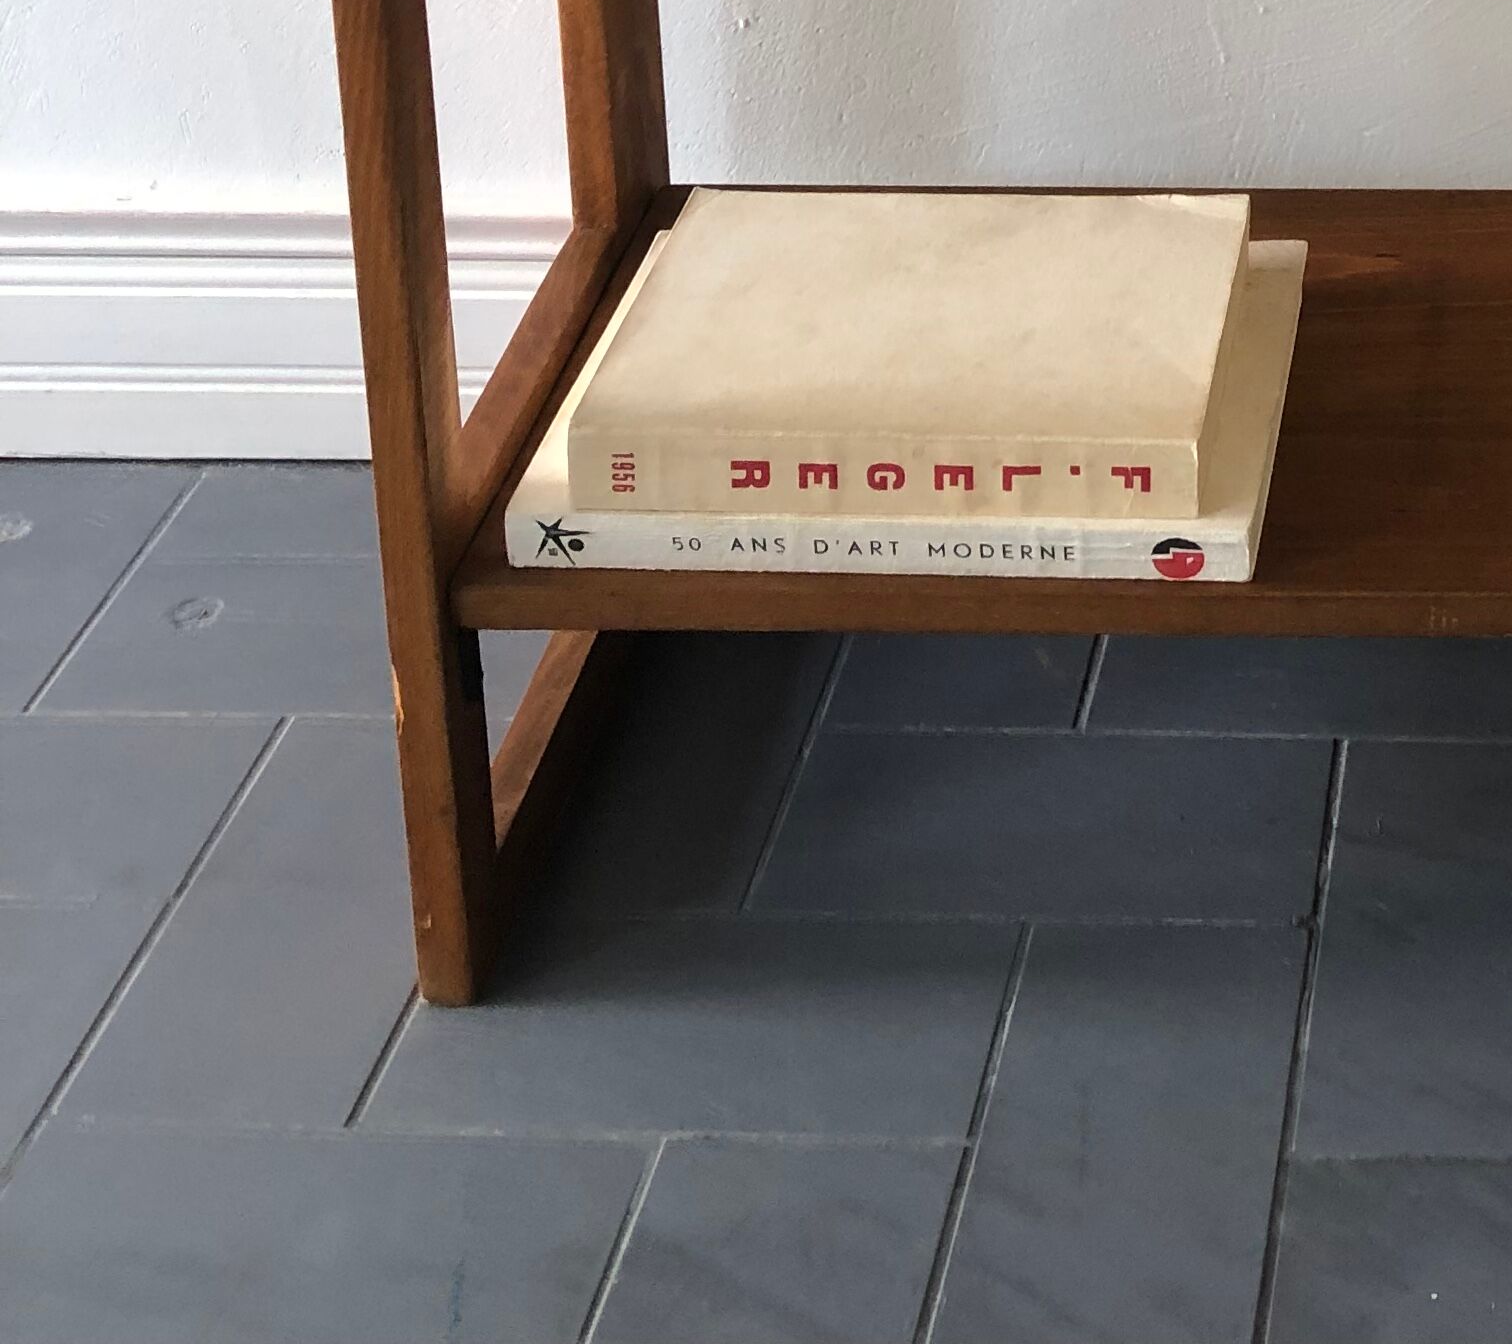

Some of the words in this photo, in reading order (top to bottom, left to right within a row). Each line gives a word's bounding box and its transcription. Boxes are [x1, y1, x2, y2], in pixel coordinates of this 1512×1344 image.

[611, 452, 637, 494] 1956
[671, 536, 702, 552] 50
[730, 537, 787, 554] ANS
[813, 539, 900, 557] D'ART
[928, 542, 1077, 562] MODERNE
